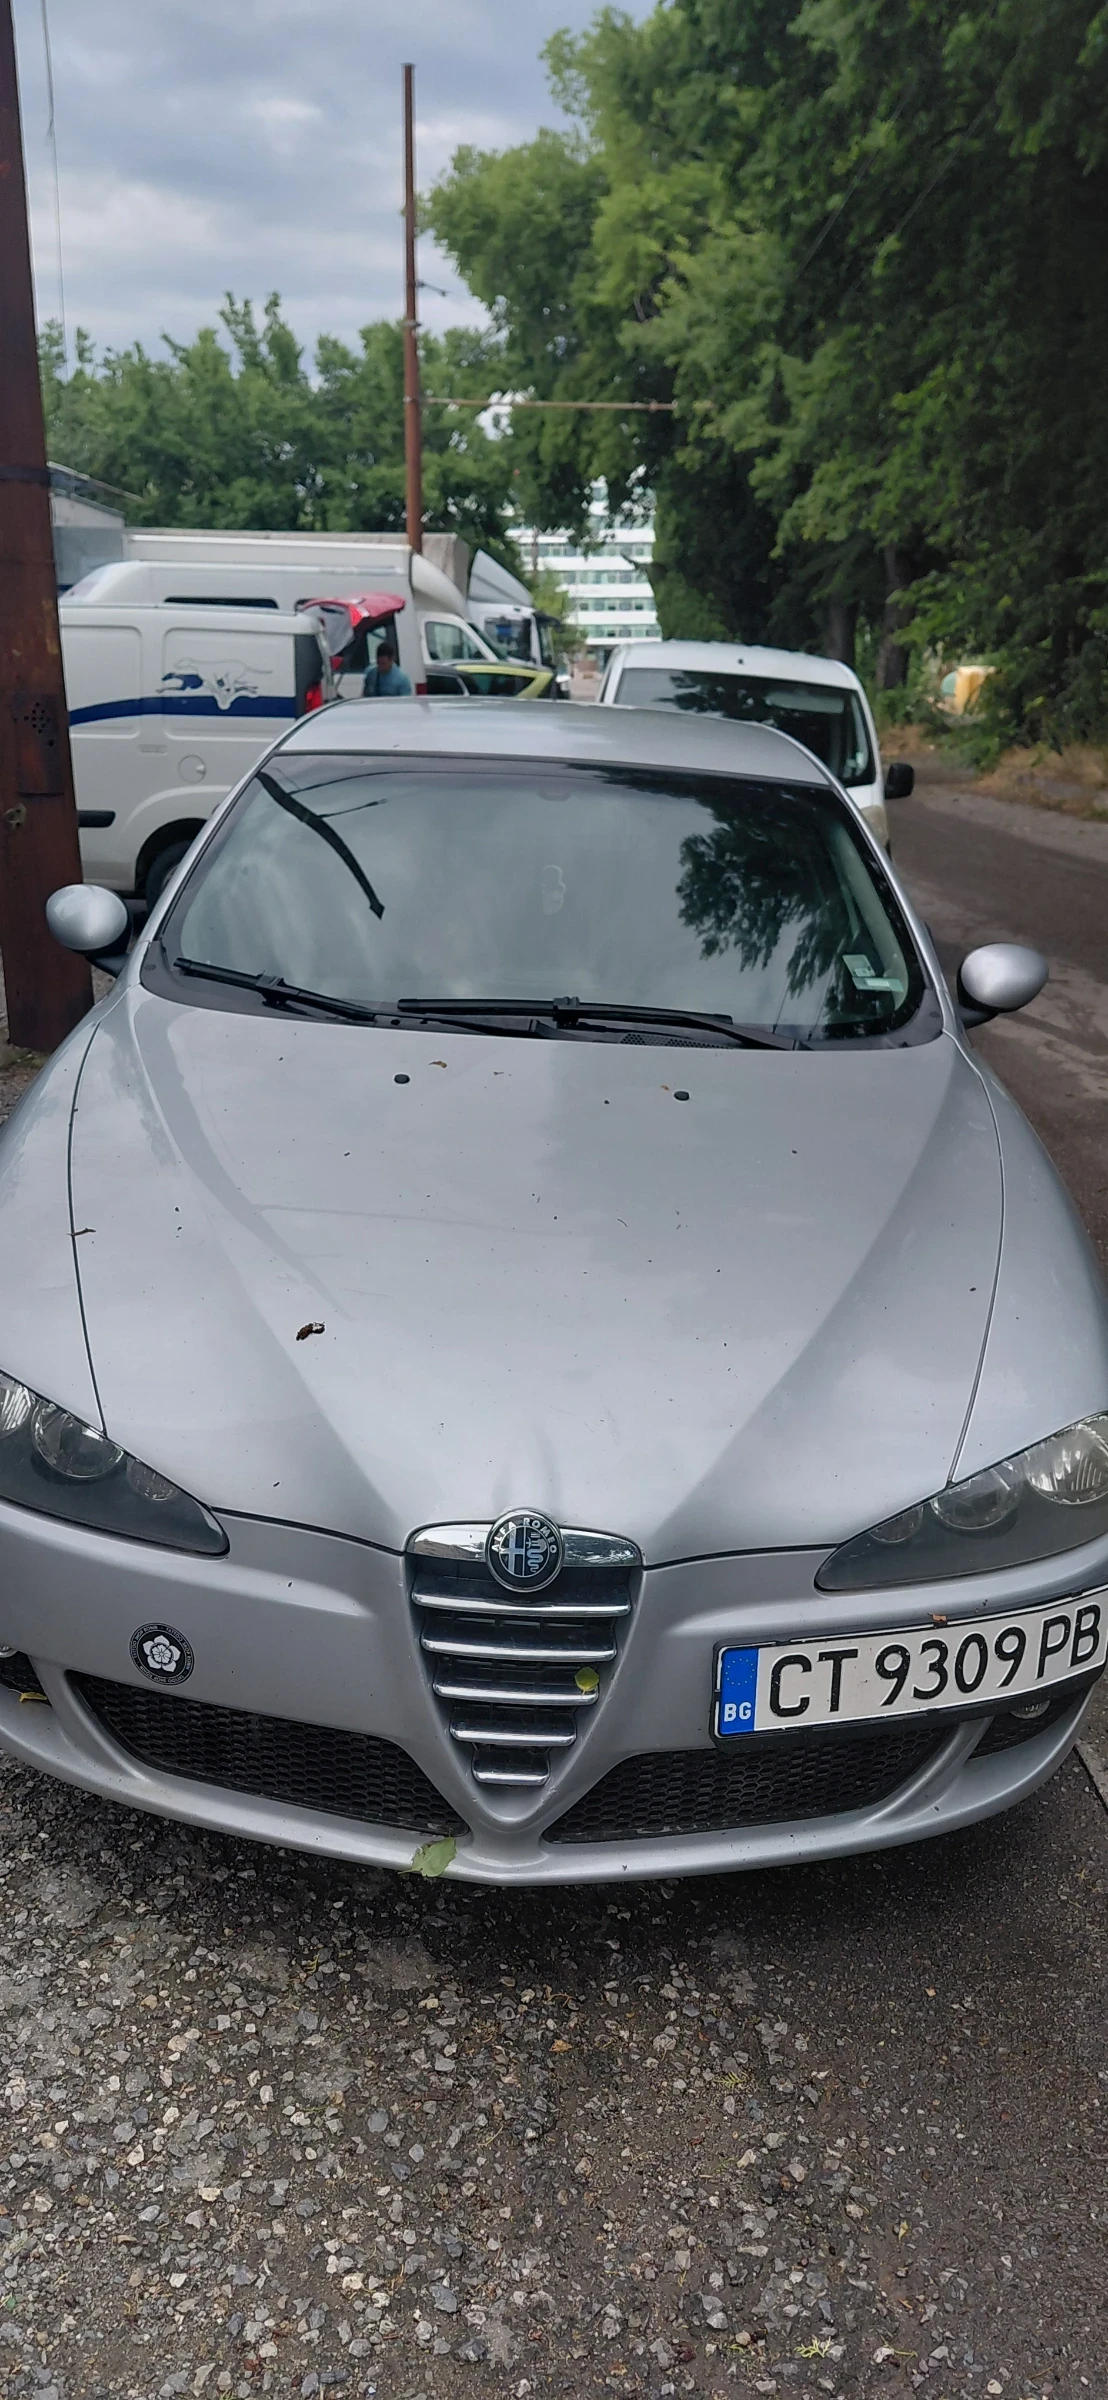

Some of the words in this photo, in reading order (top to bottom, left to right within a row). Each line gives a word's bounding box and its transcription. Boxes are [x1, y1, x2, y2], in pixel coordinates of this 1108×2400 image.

[491, 1521, 516, 1552] ALFA
[523, 1517, 557, 1554] ROMEO
[723, 1702, 752, 1722] BG
[770, 1648, 860, 1717] CT
[875, 1626, 1027, 1706] 9309
[1035, 1604, 1101, 1681] PB
